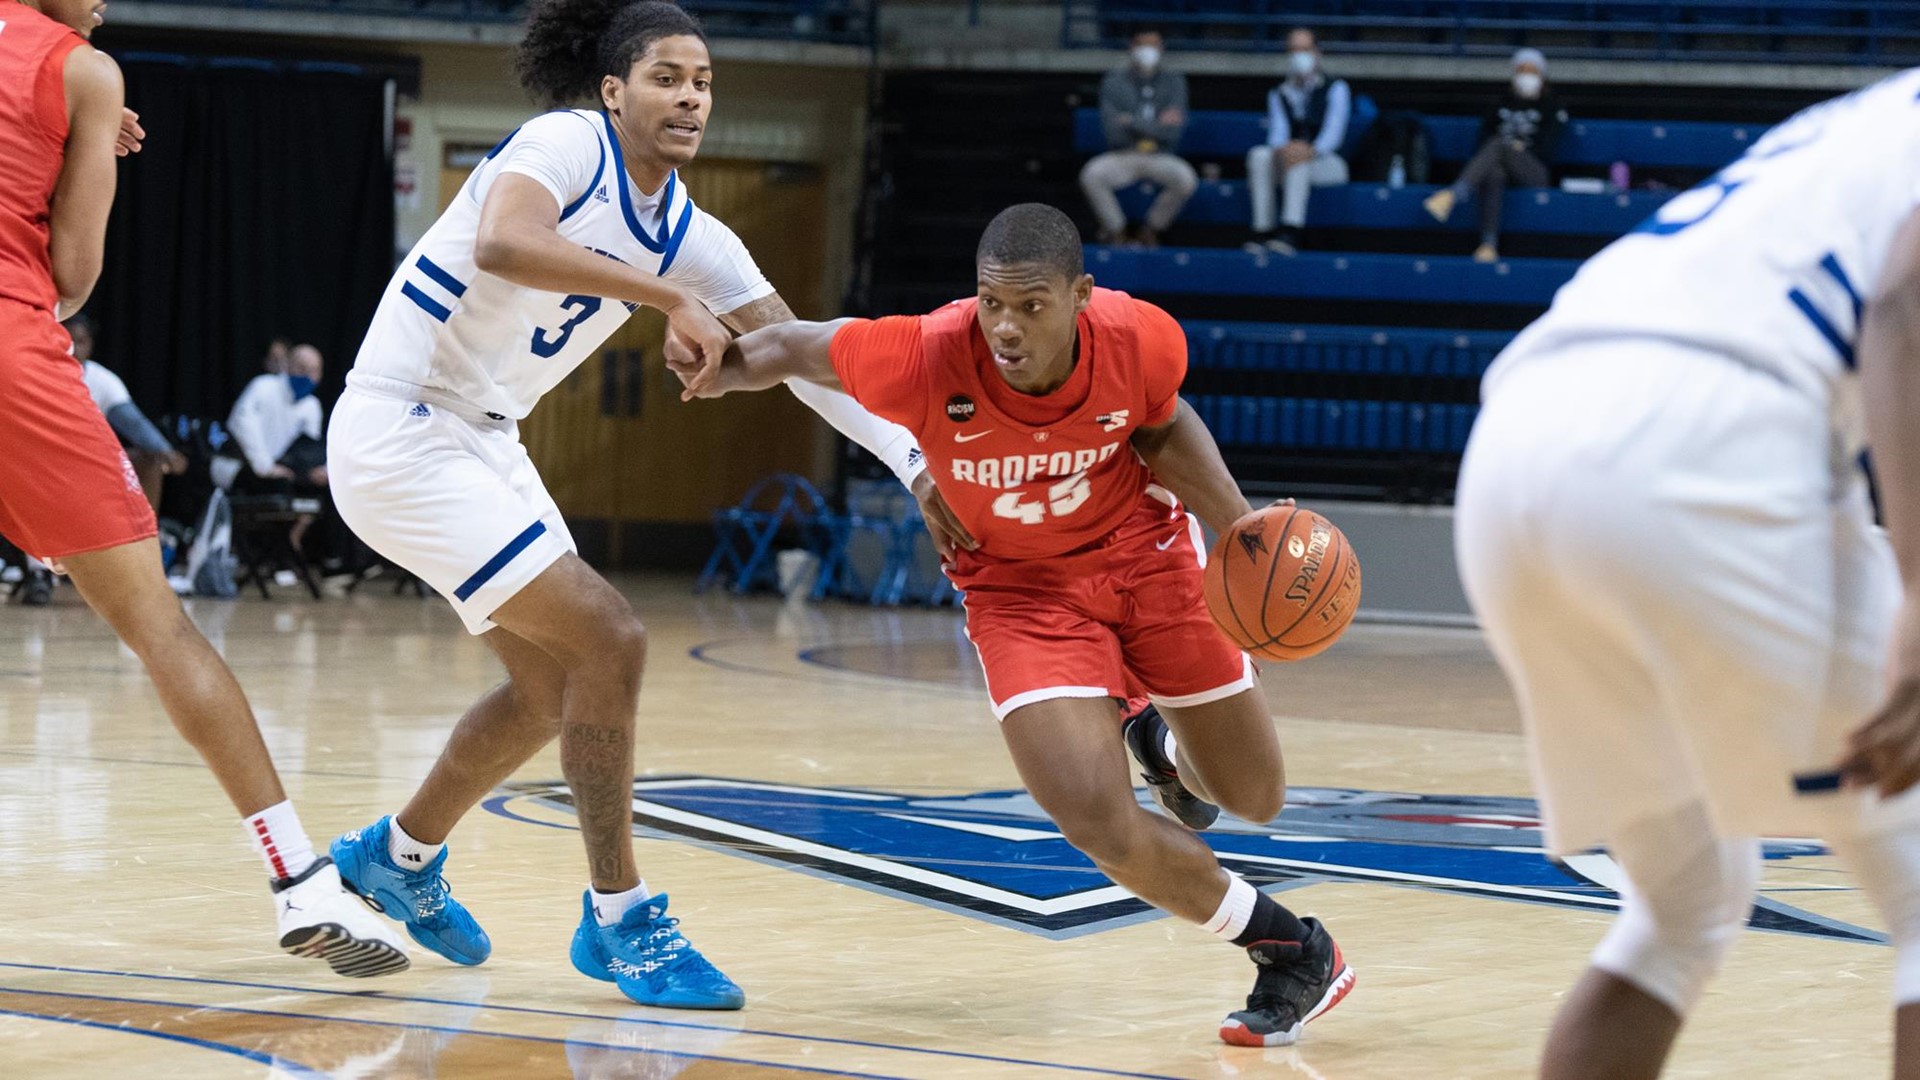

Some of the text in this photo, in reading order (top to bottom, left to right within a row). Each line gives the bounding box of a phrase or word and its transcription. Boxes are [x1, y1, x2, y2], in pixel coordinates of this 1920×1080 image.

[531, 294, 602, 359] 3
[947, 403, 975, 414] RACISM
[992, 470, 1092, 525] 45
